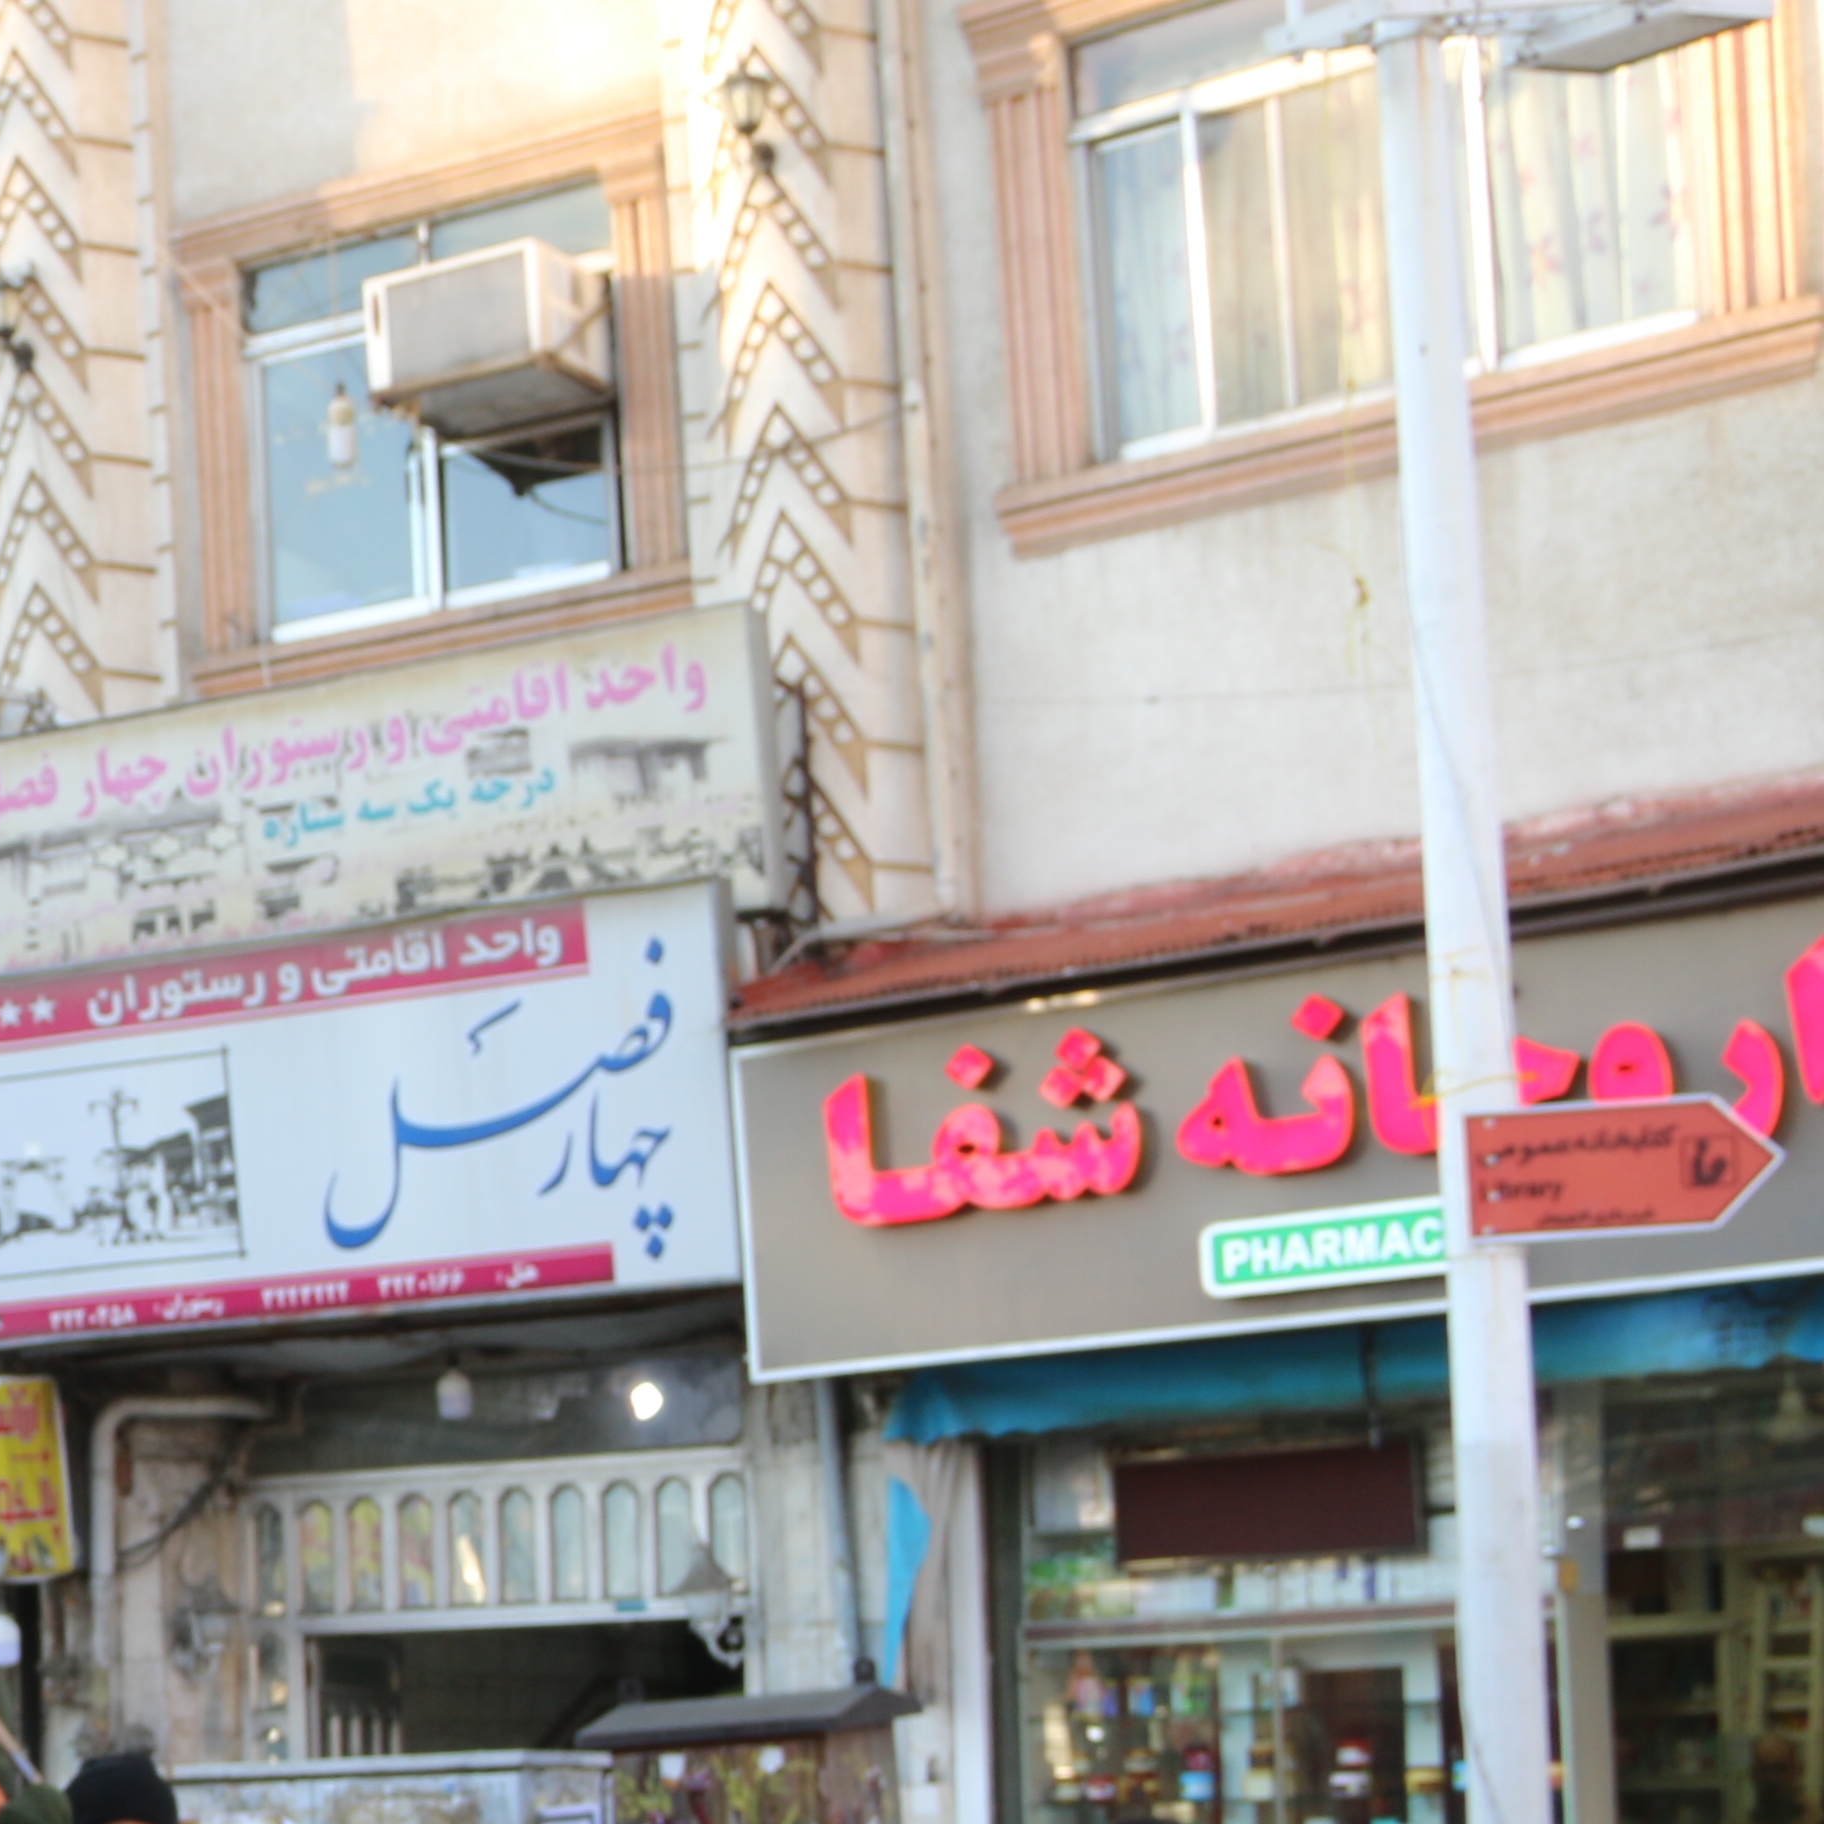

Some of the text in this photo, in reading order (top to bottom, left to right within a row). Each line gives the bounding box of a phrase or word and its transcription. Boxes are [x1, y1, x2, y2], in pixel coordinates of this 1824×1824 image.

[585, 642, 708, 712] واحد
[76, 747, 168, 819] چهار
[310, 929, 445, 998] اقامتی
[459, 917, 563, 968] واحد
[87, 968, 267, 1027] رستوران
[277, 961, 303, 1001] و
[821, 932, 1824, 1227] اروانه شفا
[1221, 1215, 1444, 1279] PHARMAC
